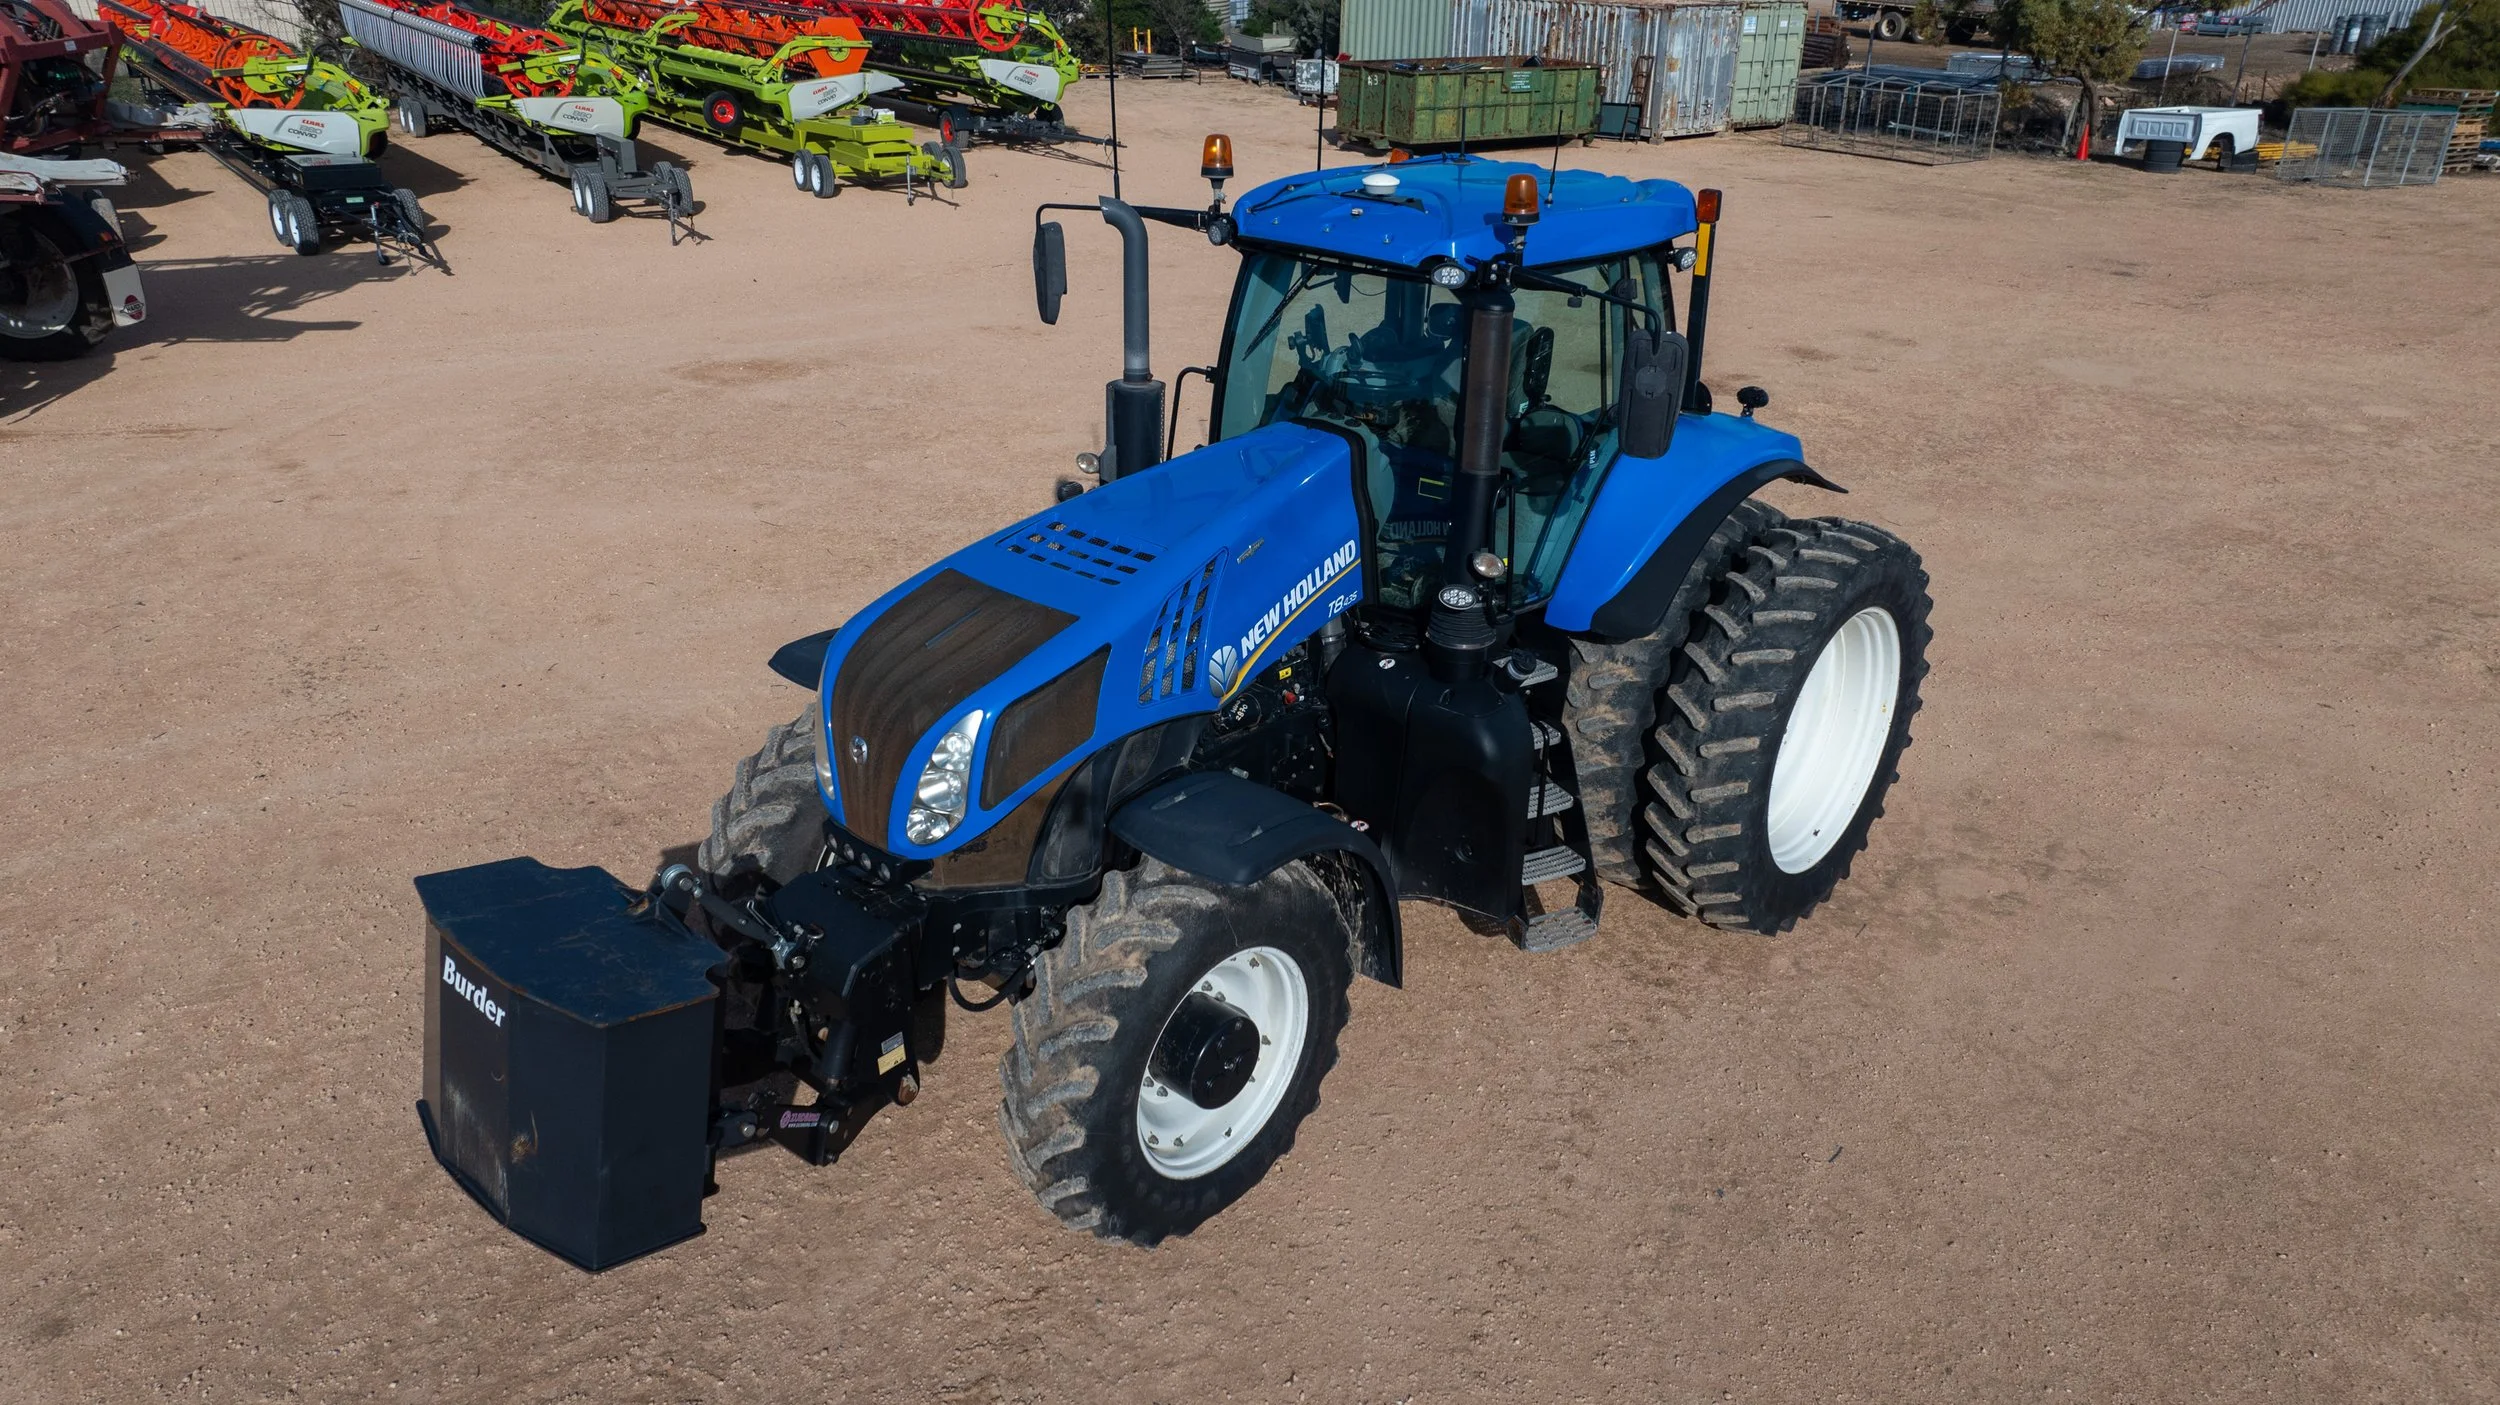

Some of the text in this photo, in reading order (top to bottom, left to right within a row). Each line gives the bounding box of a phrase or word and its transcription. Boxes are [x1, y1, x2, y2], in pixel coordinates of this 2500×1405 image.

[575, 104, 595, 113] CLAAS
[302, 119, 325, 128] CLAAS
[288, 128, 317, 139] CONVIO
[1240, 603, 1280, 659] NEW
[1283, 539, 1356, 617] HOLLAND
[442, 954, 506, 1028] Burder
